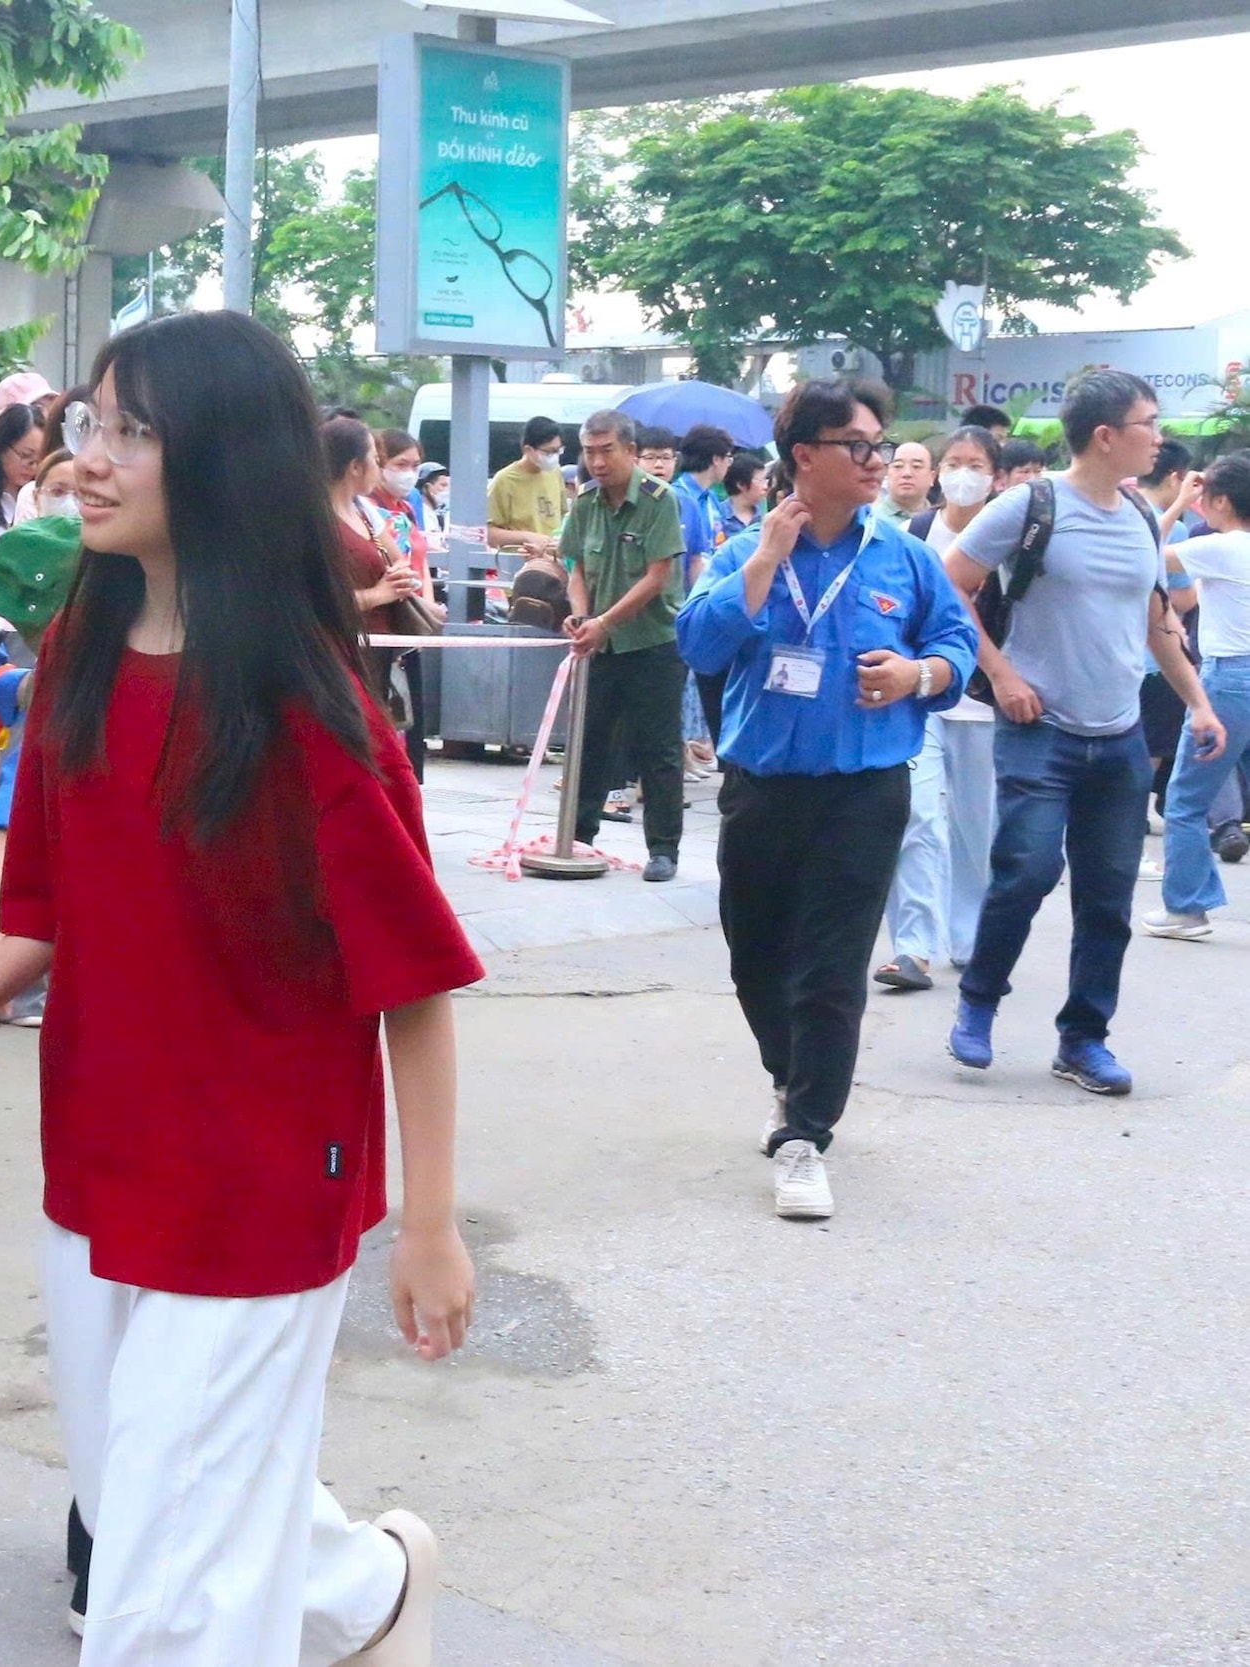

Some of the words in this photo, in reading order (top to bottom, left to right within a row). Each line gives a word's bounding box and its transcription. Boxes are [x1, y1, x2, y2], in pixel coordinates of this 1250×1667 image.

[450, 106, 477, 125] Thu
[479, 109, 509, 129] kính
[1144, 373, 1209, 388] TECONS
